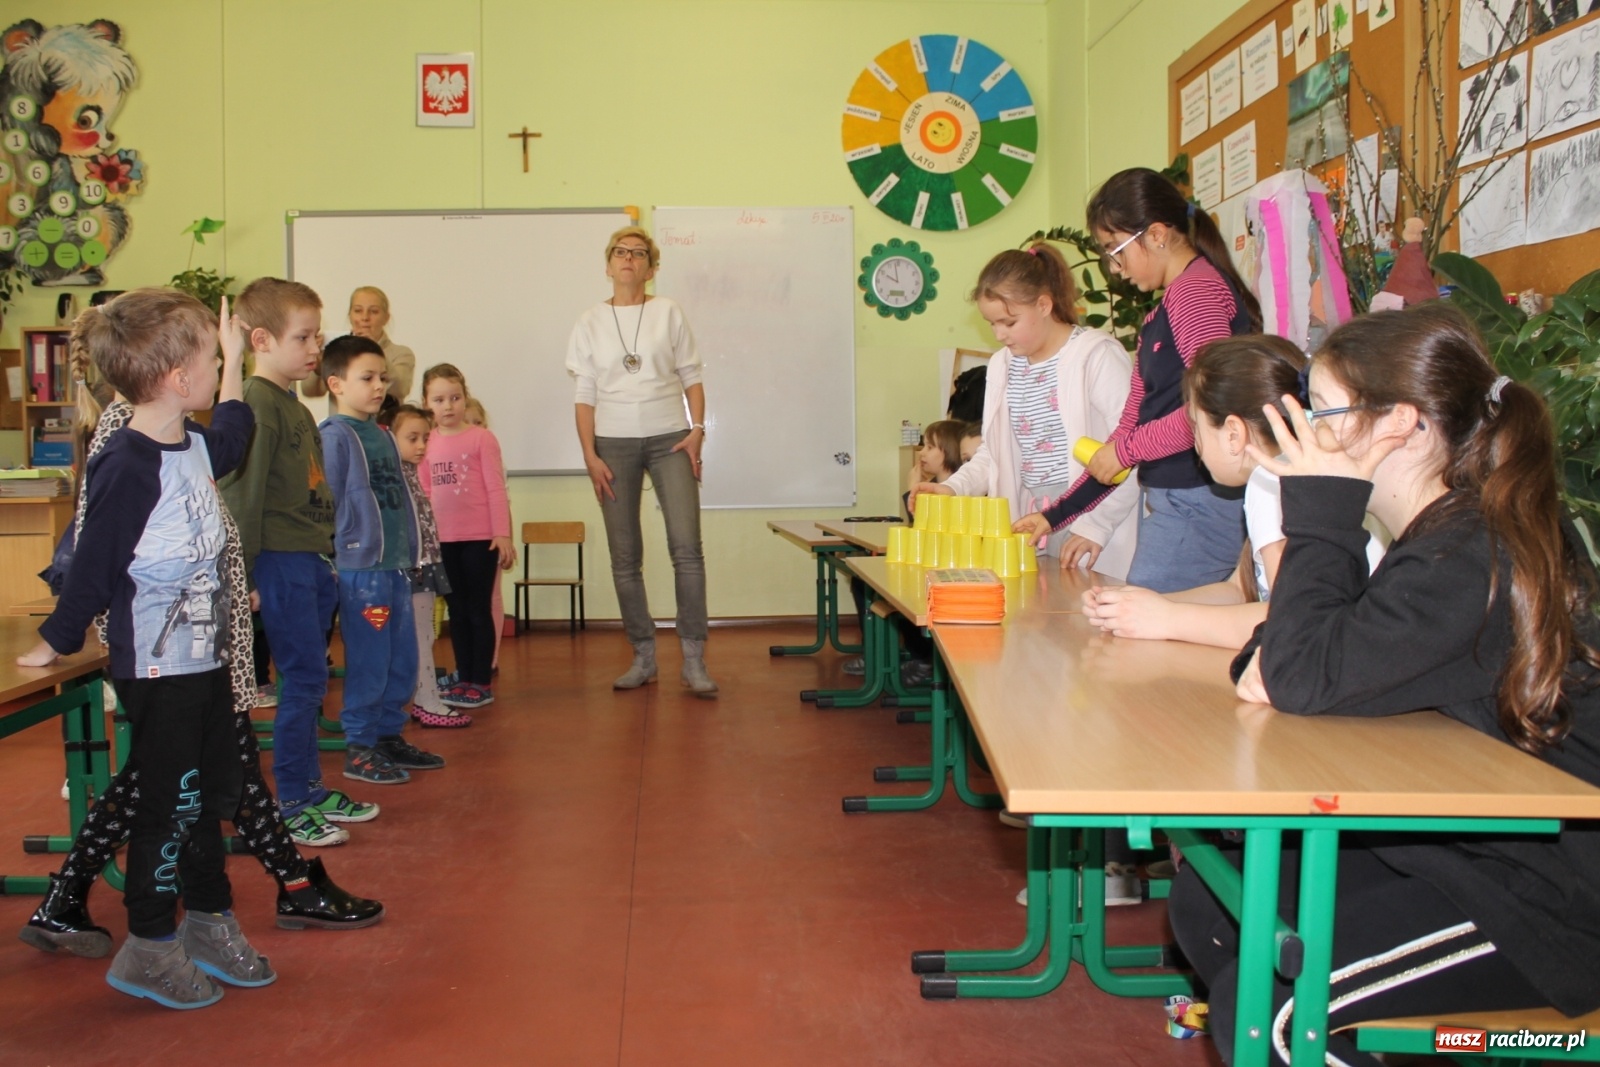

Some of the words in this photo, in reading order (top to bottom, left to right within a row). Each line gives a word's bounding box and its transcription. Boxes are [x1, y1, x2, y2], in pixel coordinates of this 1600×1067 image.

[17, 102, 26, 114] 8
[944, 95, 966, 111] ZIMA
[12, 135, 21, 147] 1
[956, 130, 979, 164] WIOSNA
[911, 152, 935, 169] LATO
[33, 167, 41, 179] 6
[85, 185, 101, 197] 10
[17, 199, 26, 211] 3
[59, 196, 69, 209] 9
[82, 221, 91, 233] 0
[3, 232, 11, 245] 7
